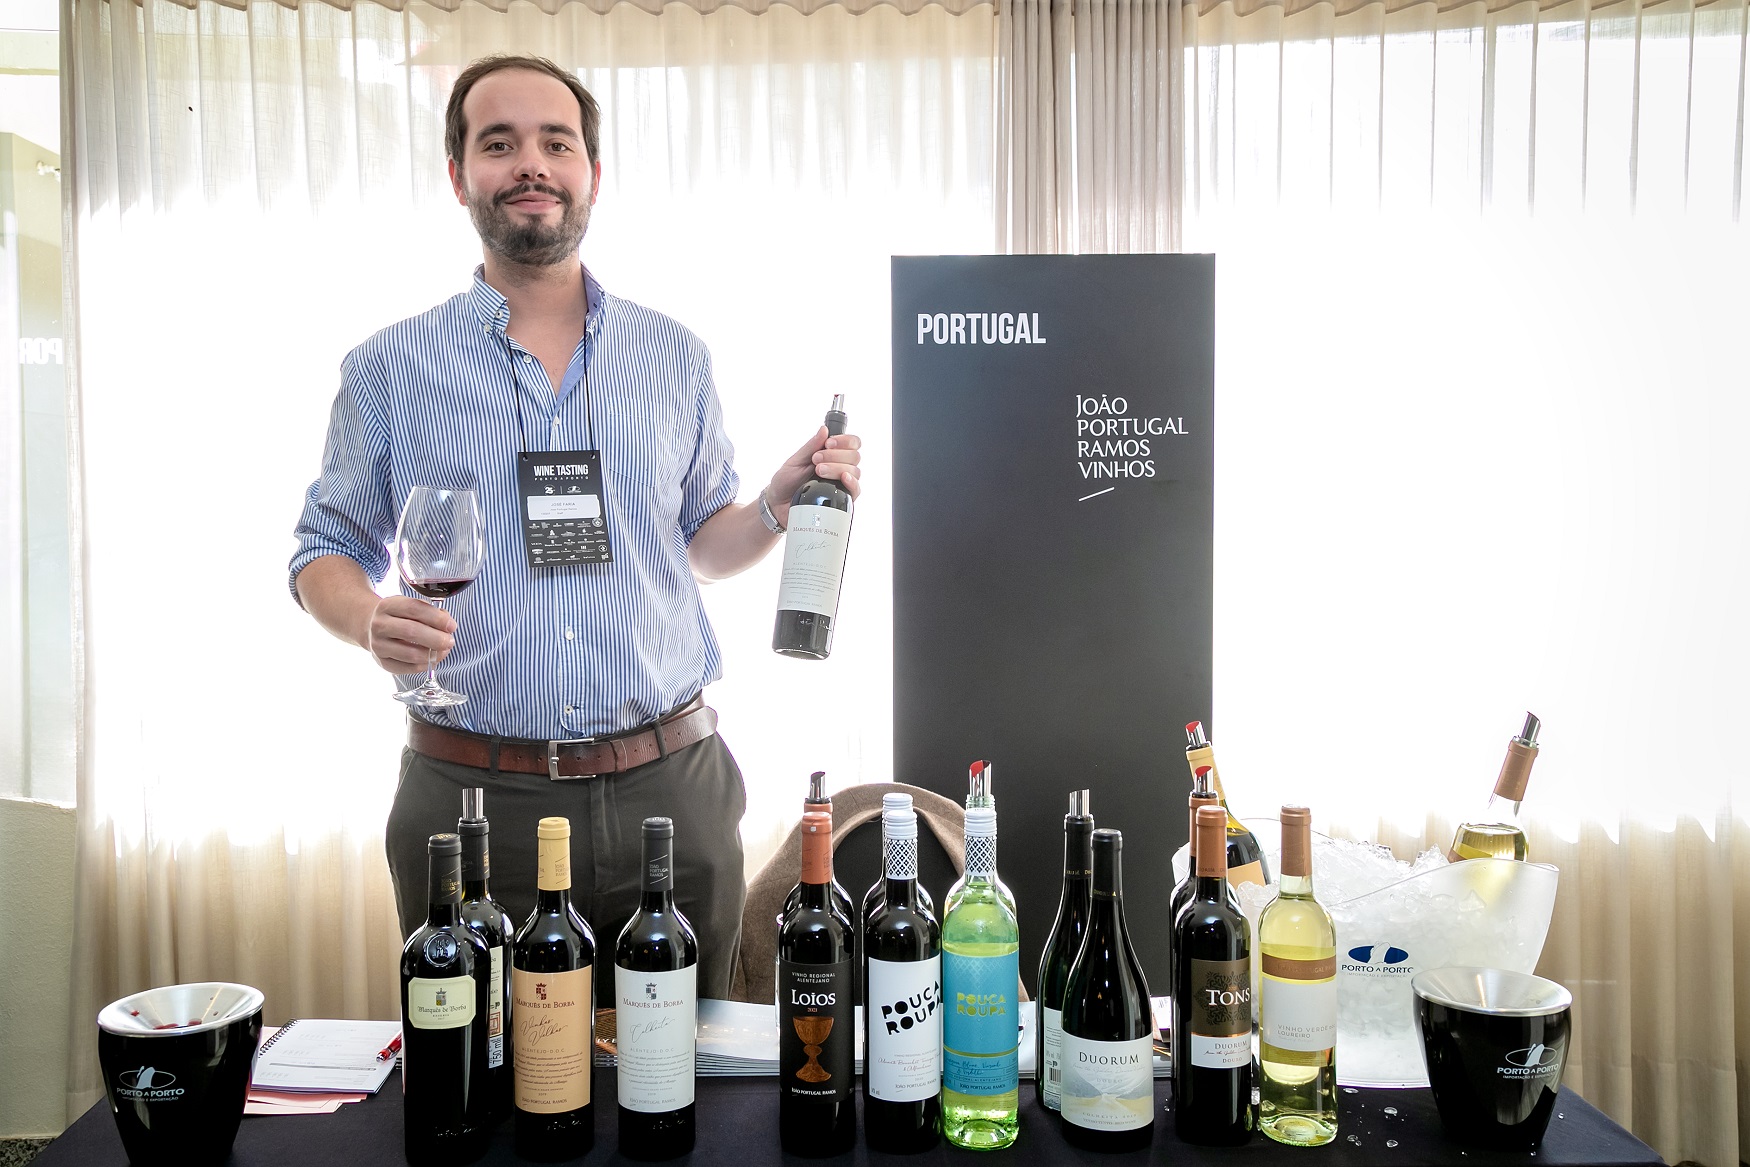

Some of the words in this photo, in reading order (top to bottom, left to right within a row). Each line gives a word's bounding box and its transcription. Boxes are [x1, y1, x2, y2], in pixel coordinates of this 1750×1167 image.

[918, 313, 1046, 344] PORTUGAL
[1076, 394, 1127, 418] JOÃO
[1077, 418, 1188, 436] PORTUGAL
[1078, 440, 1150, 457] RAMOS
[534, 466, 555, 476] WINE
[556, 464, 588, 475] TASTING
[1078, 460, 1155, 478] VINHOS
[516, 997, 540, 1008] MARQUÊS
[623, 998, 650, 1008] MARQUÊS
[664, 1000, 683, 1008] BORBA
[881, 980, 939, 1019] POUCA
[957, 992, 1006, 1005] POUCA
[1206, 988, 1250, 1006] TONS
[418, 1006, 441, 1014] Marquês
[450, 1004, 466, 1012] Borba
[886, 994, 940, 1035] ROUPA
[957, 1005, 1005, 1016] ROUPA
[528, 1023, 568, 1046] Velhas
[1278, 1024, 1302, 1032] VINHO
[1278, 1030, 1310, 1038] LOUREIRO
[1215, 1040, 1247, 1050] DUORUM
[492, 1050, 502, 1064] 750
[1079, 1052, 1139, 1066] DUORUM
[1536, 1064, 1558, 1074] PORTO
[117, 1088, 142, 1097] PORTO
[151, 1088, 184, 1097] PORTO
